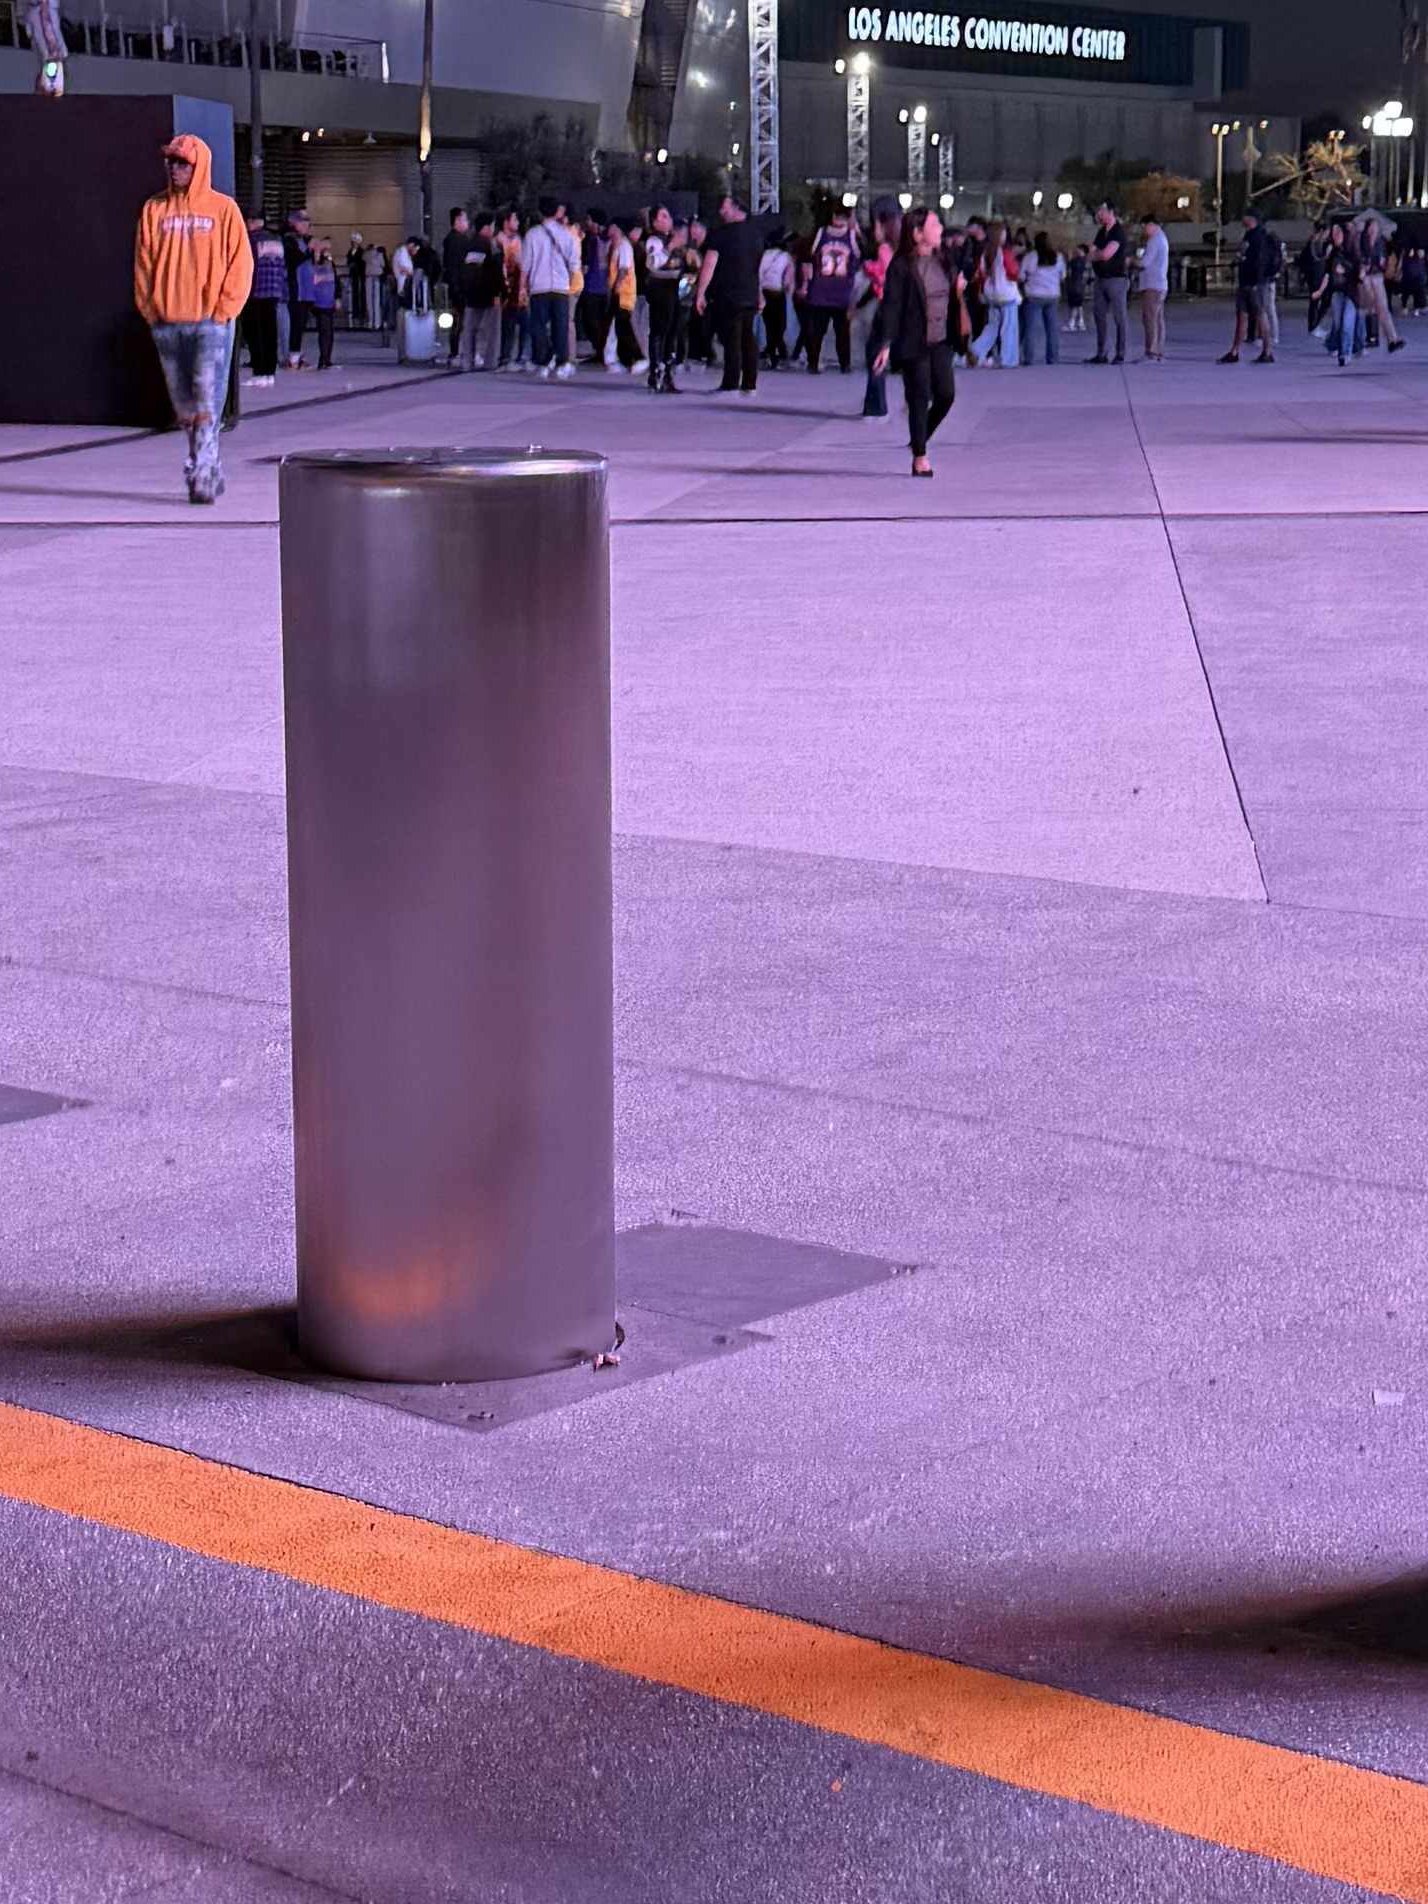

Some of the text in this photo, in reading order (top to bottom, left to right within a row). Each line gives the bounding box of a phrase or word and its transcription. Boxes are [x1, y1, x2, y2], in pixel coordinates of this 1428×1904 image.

[848, 7, 1126, 60] LOS ANGELES CONVENTION CENTER
